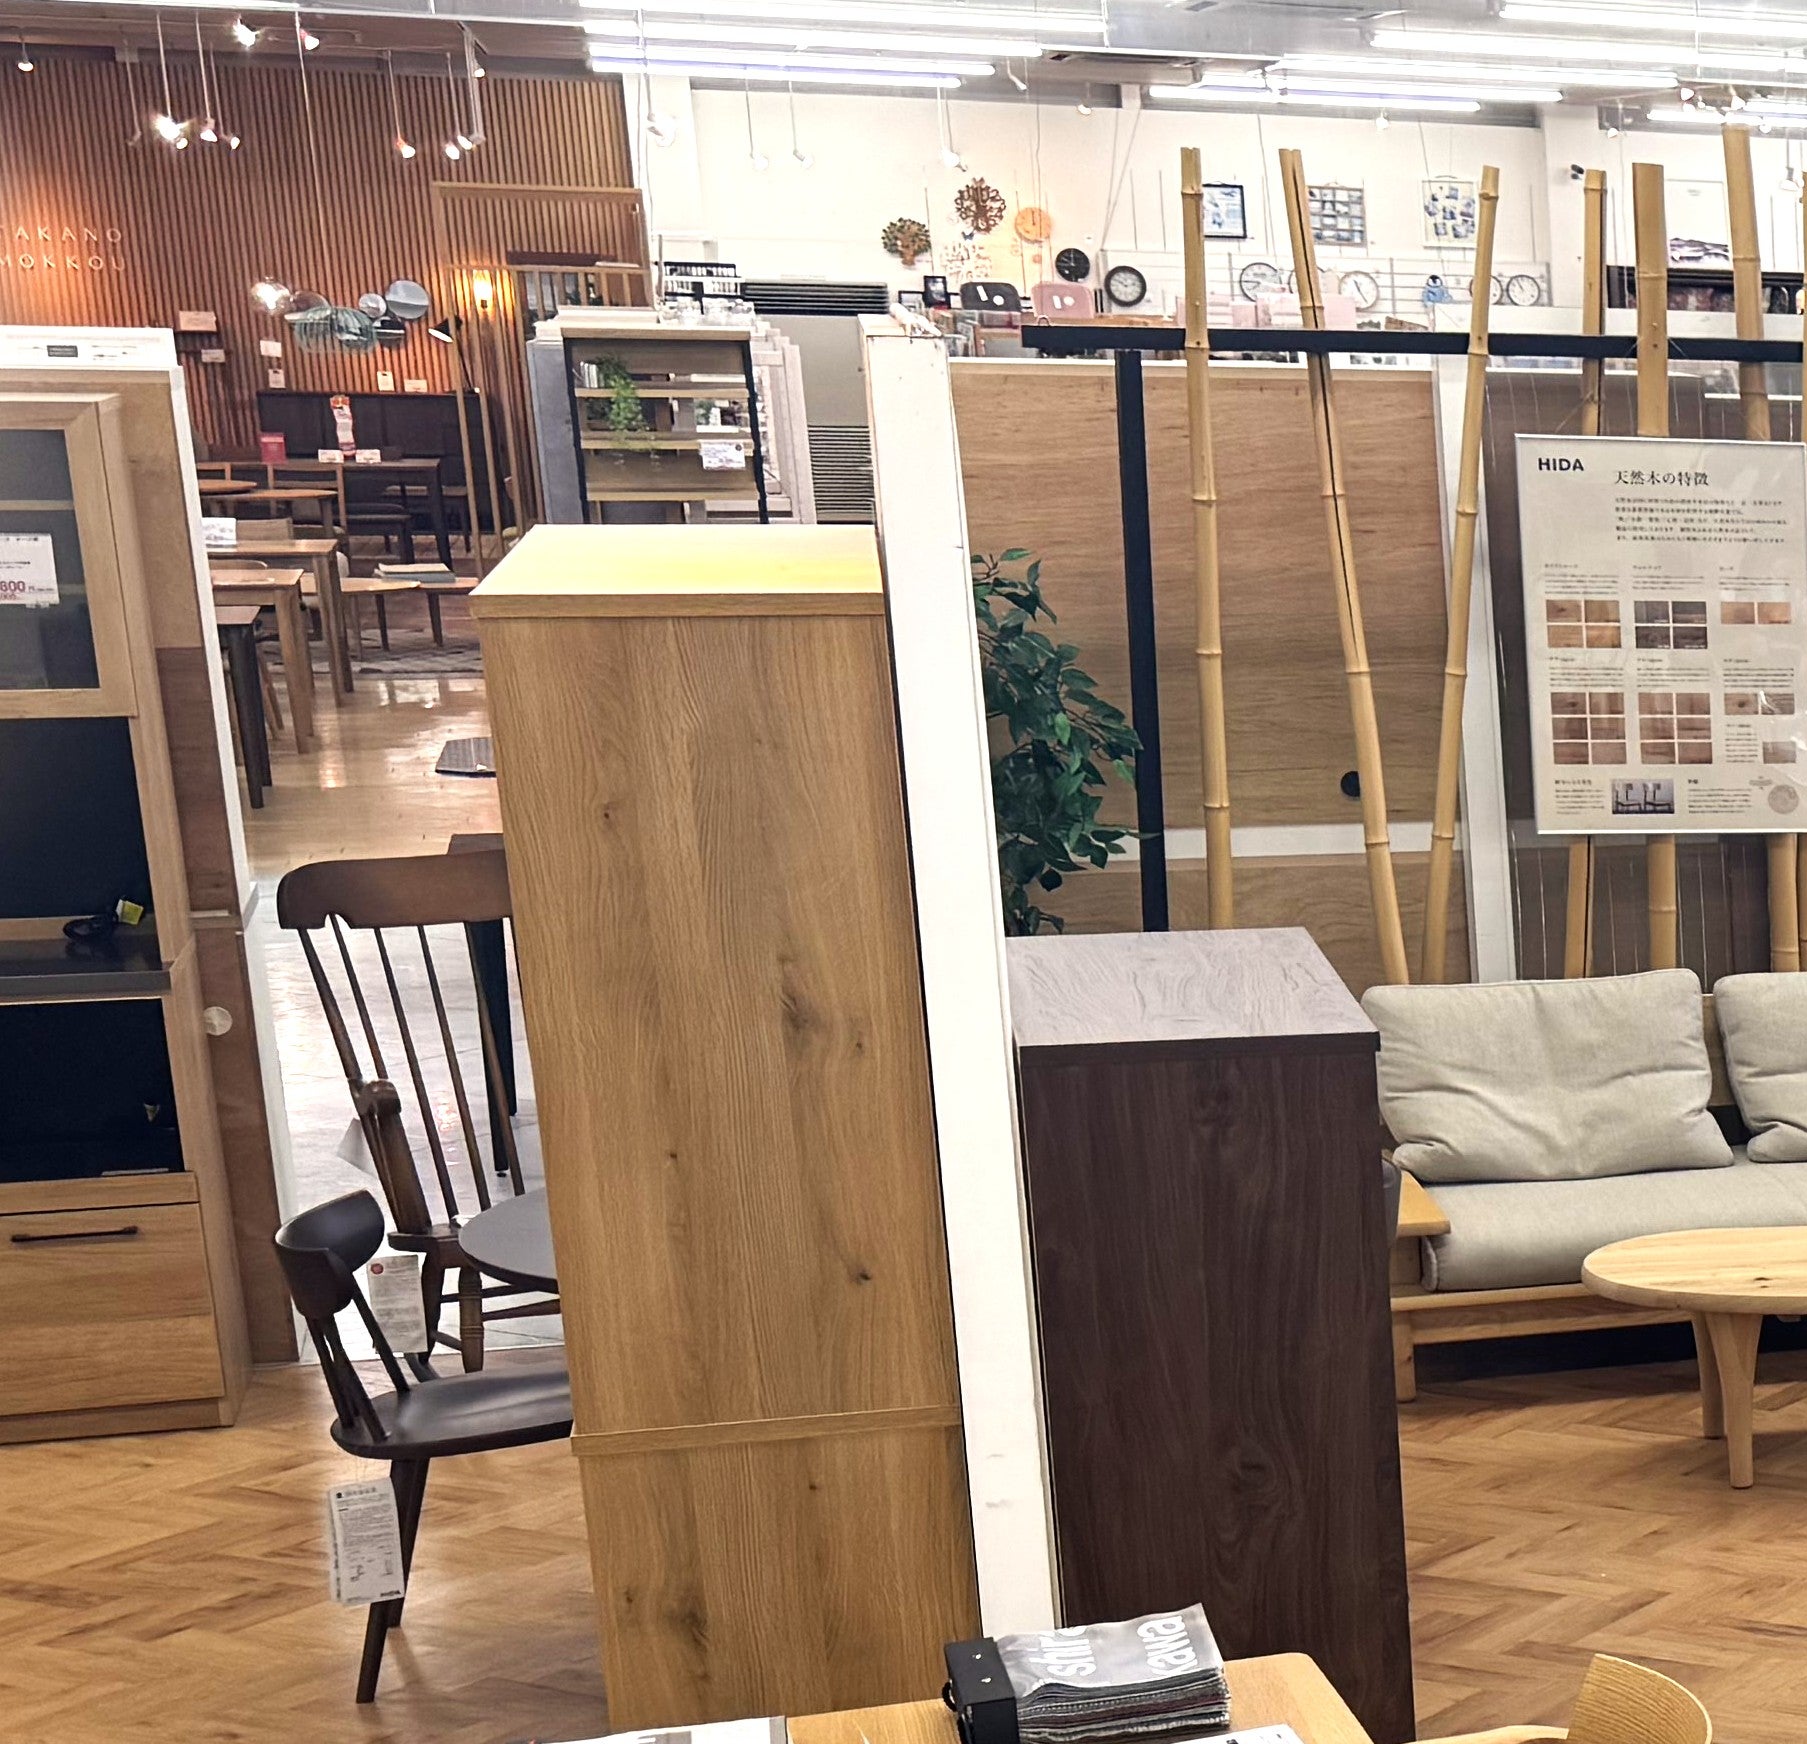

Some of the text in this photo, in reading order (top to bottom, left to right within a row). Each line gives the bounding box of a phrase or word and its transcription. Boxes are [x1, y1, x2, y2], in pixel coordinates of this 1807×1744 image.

[1538, 457, 1584, 472] HIDA
[1615, 470, 1709, 487] 天然木の特徴
